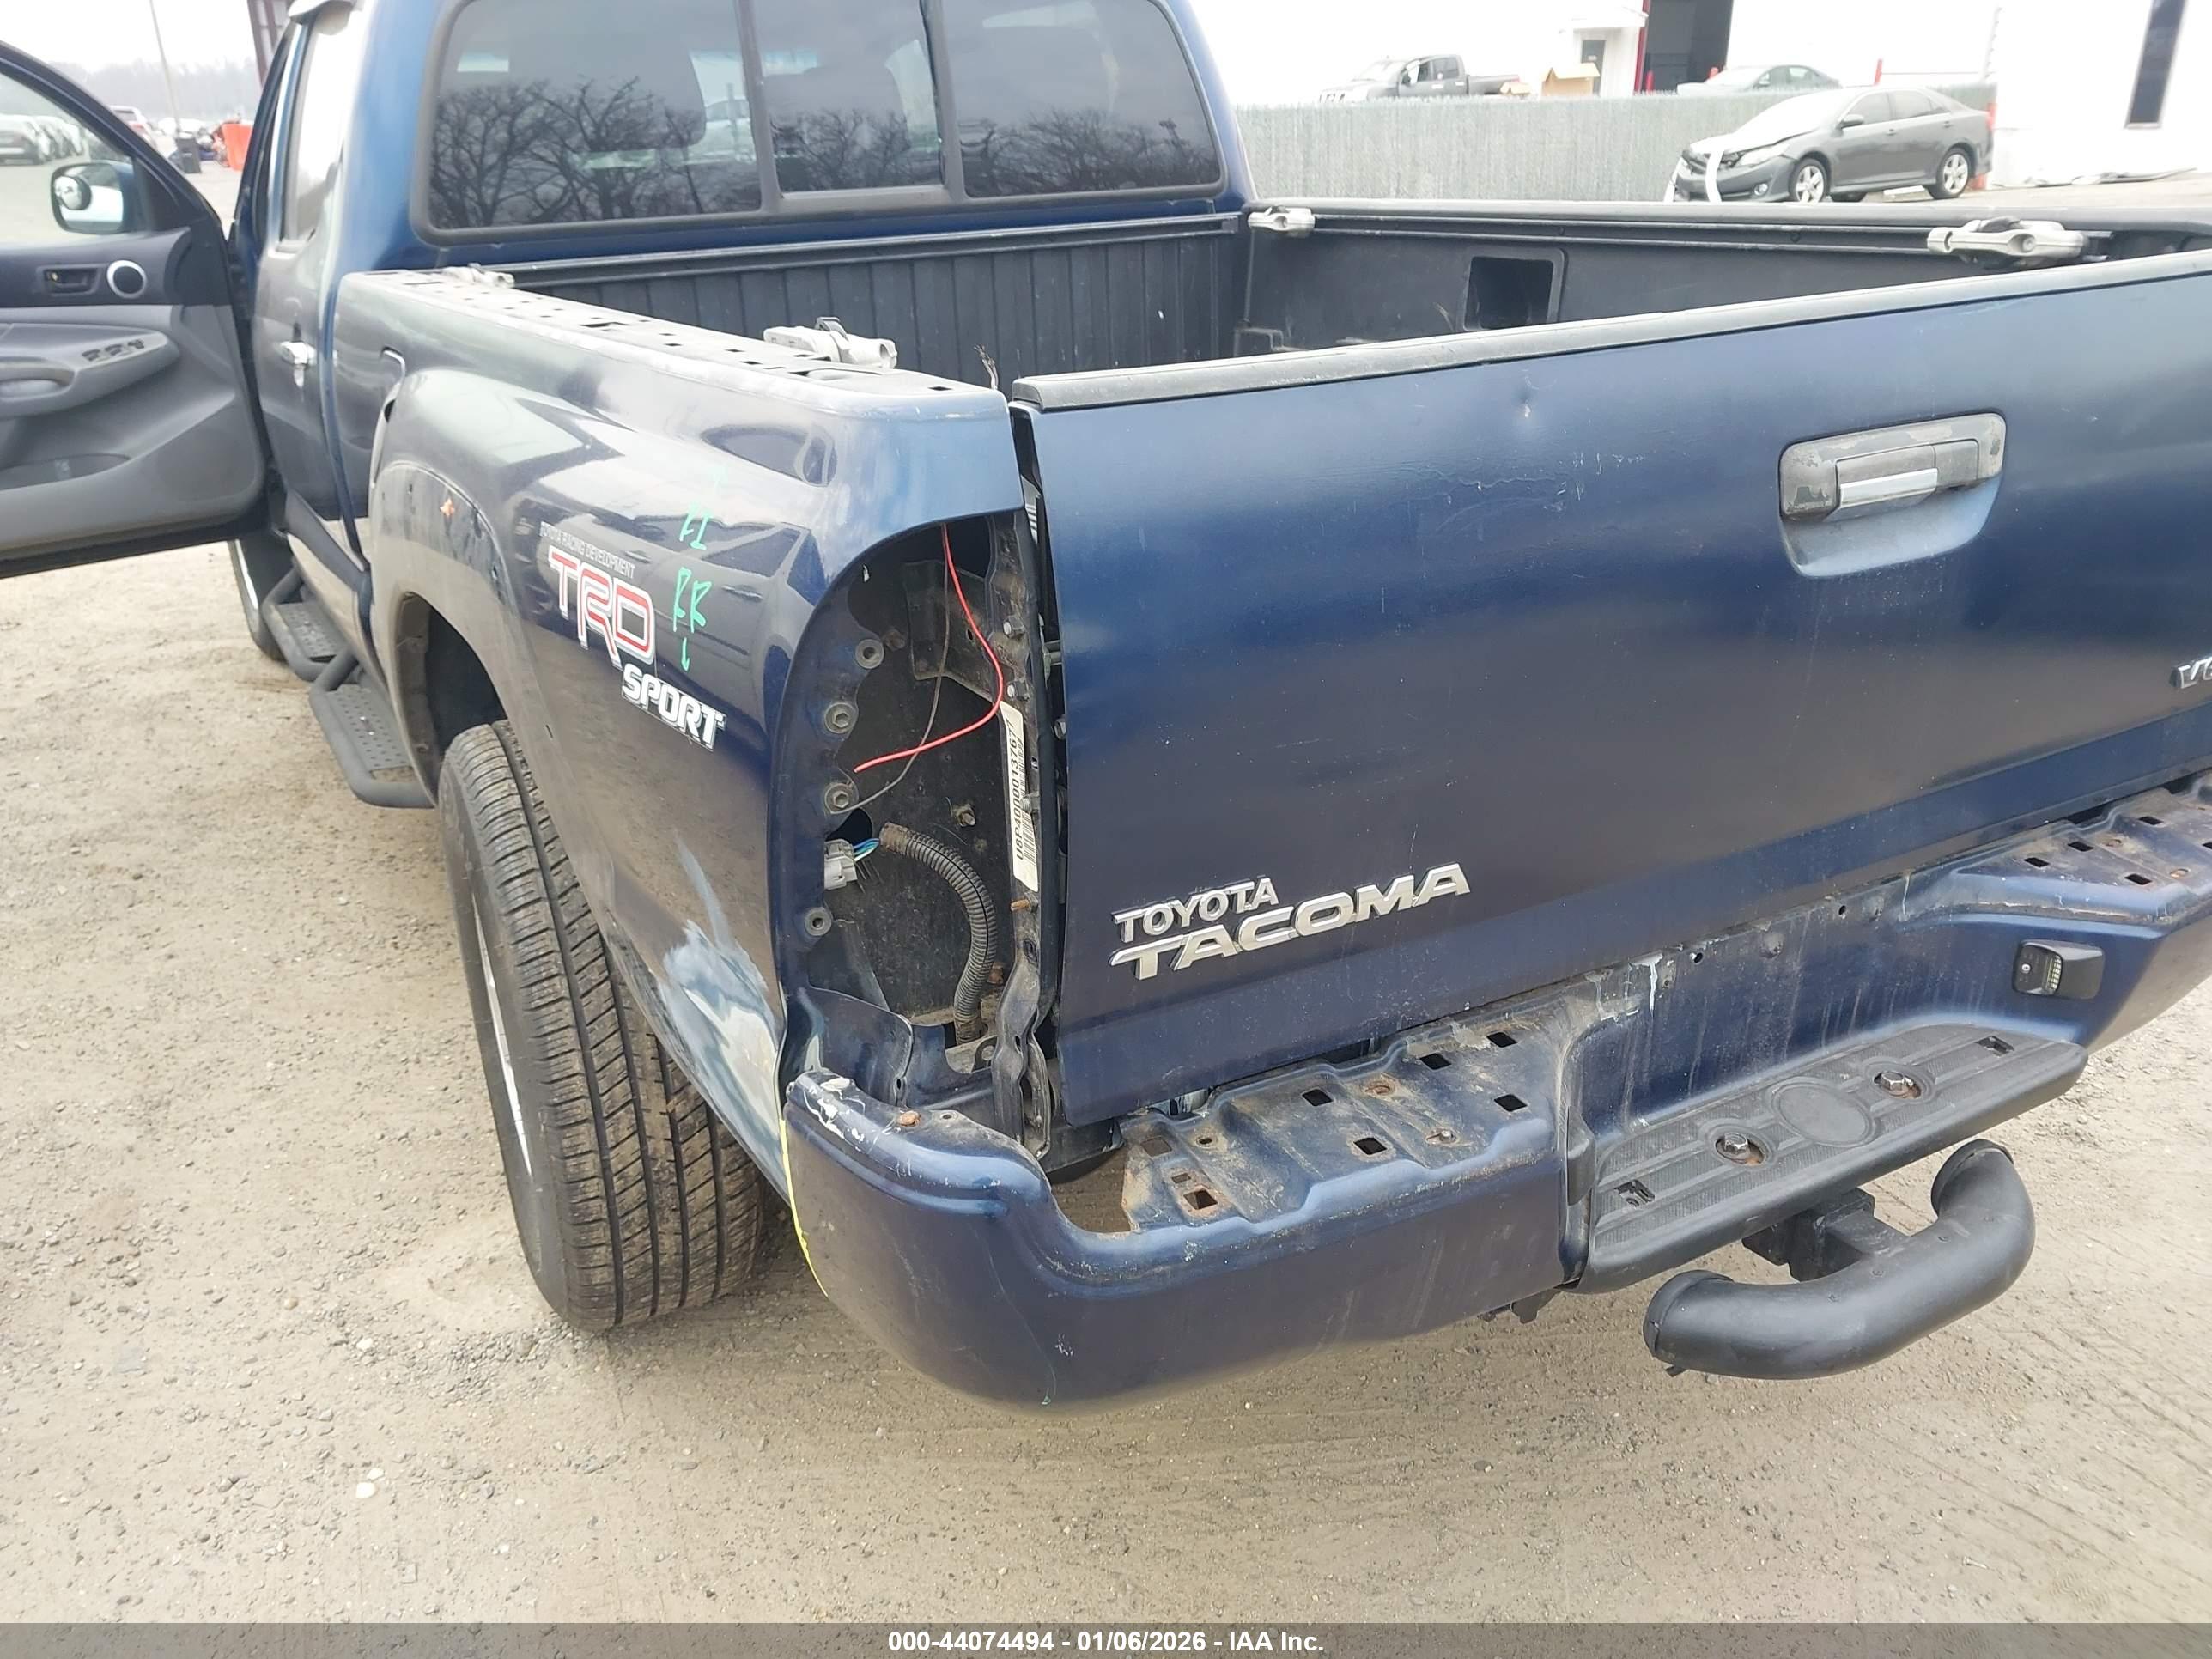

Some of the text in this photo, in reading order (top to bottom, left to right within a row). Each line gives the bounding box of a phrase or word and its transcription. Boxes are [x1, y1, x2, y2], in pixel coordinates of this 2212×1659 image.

[585, 543, 635, 579] DEVELOPMENT
[549, 544, 655, 672] TRD
[622, 663, 720, 750] SPORT
[1109, 862, 1470, 981] TACOMA
[1112, 876, 1279, 943] TOYOTA
